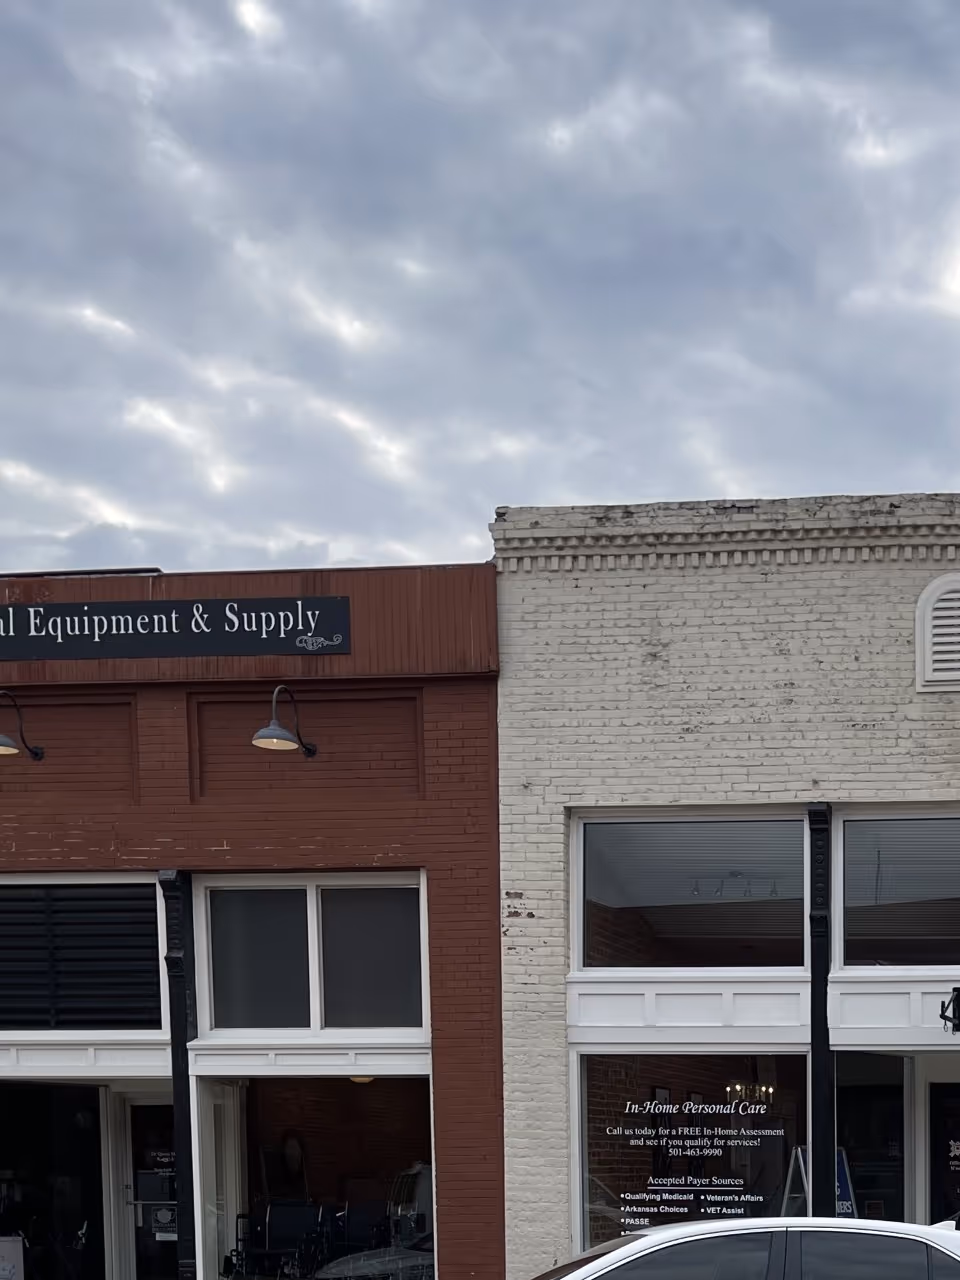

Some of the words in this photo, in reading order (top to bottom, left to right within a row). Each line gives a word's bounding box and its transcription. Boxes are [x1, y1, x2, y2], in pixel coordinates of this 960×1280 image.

[29, 605, 180, 644] Equipment
[191, 602, 212, 634] &
[224, 600, 320, 637] Supply
[624, 1100, 679, 1114] In-Home
[682, 1101, 736, 1114] Personal
[739, 1102, 767, 1115] Care
[606, 1126, 622, 1135] Call
[635, 1127, 656, 1137] today
[658, 1127, 669, 1135] for
[703, 1128, 738, 1136] In-Home
[740, 1128, 785, 1136] Assessment
[660, 1137, 666, 1145] if
[668, 1139, 683, 1148] you
[684, 1137, 712, 1148] qualify
[714, 1137, 725, 1145] for
[727, 1137, 761, 1146] services!
[647, 1176, 685, 1186] Accepted
[687, 1177, 710, 1186] Payer
[712, 1177, 744, 1185] Sources
[625, 1193, 661, 1201] Qualifying
[662, 1193, 694, 1201] Medicaid
